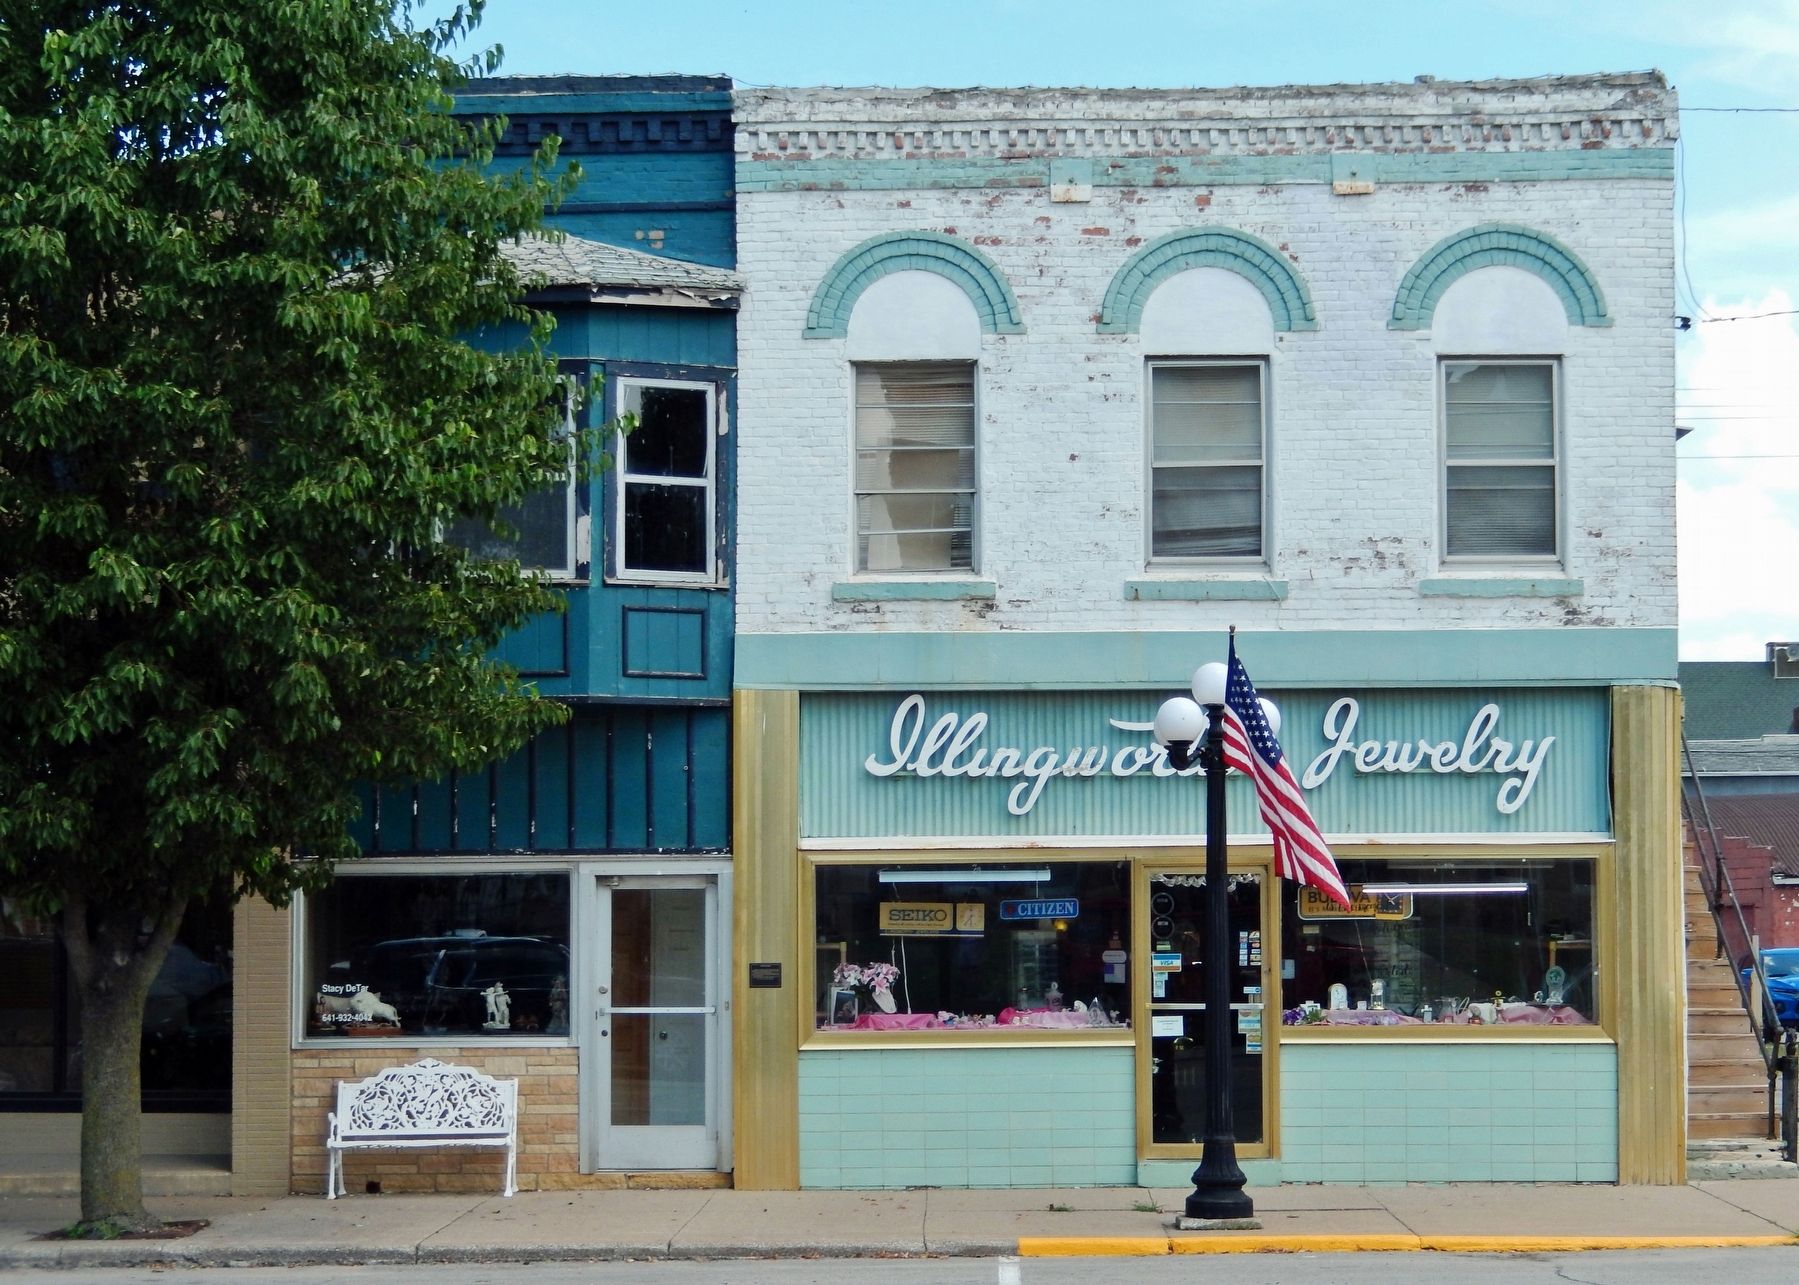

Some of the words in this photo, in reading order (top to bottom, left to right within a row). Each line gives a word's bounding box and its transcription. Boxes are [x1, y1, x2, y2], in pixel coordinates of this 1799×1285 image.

[1302, 697, 1556, 814] Jewelry
[889, 909, 947, 922] SEIKO
[1017, 902, 1074, 916] CITIZEN
[322, 984, 344, 994] Stacy
[345, 984, 369, 993] DeTar
